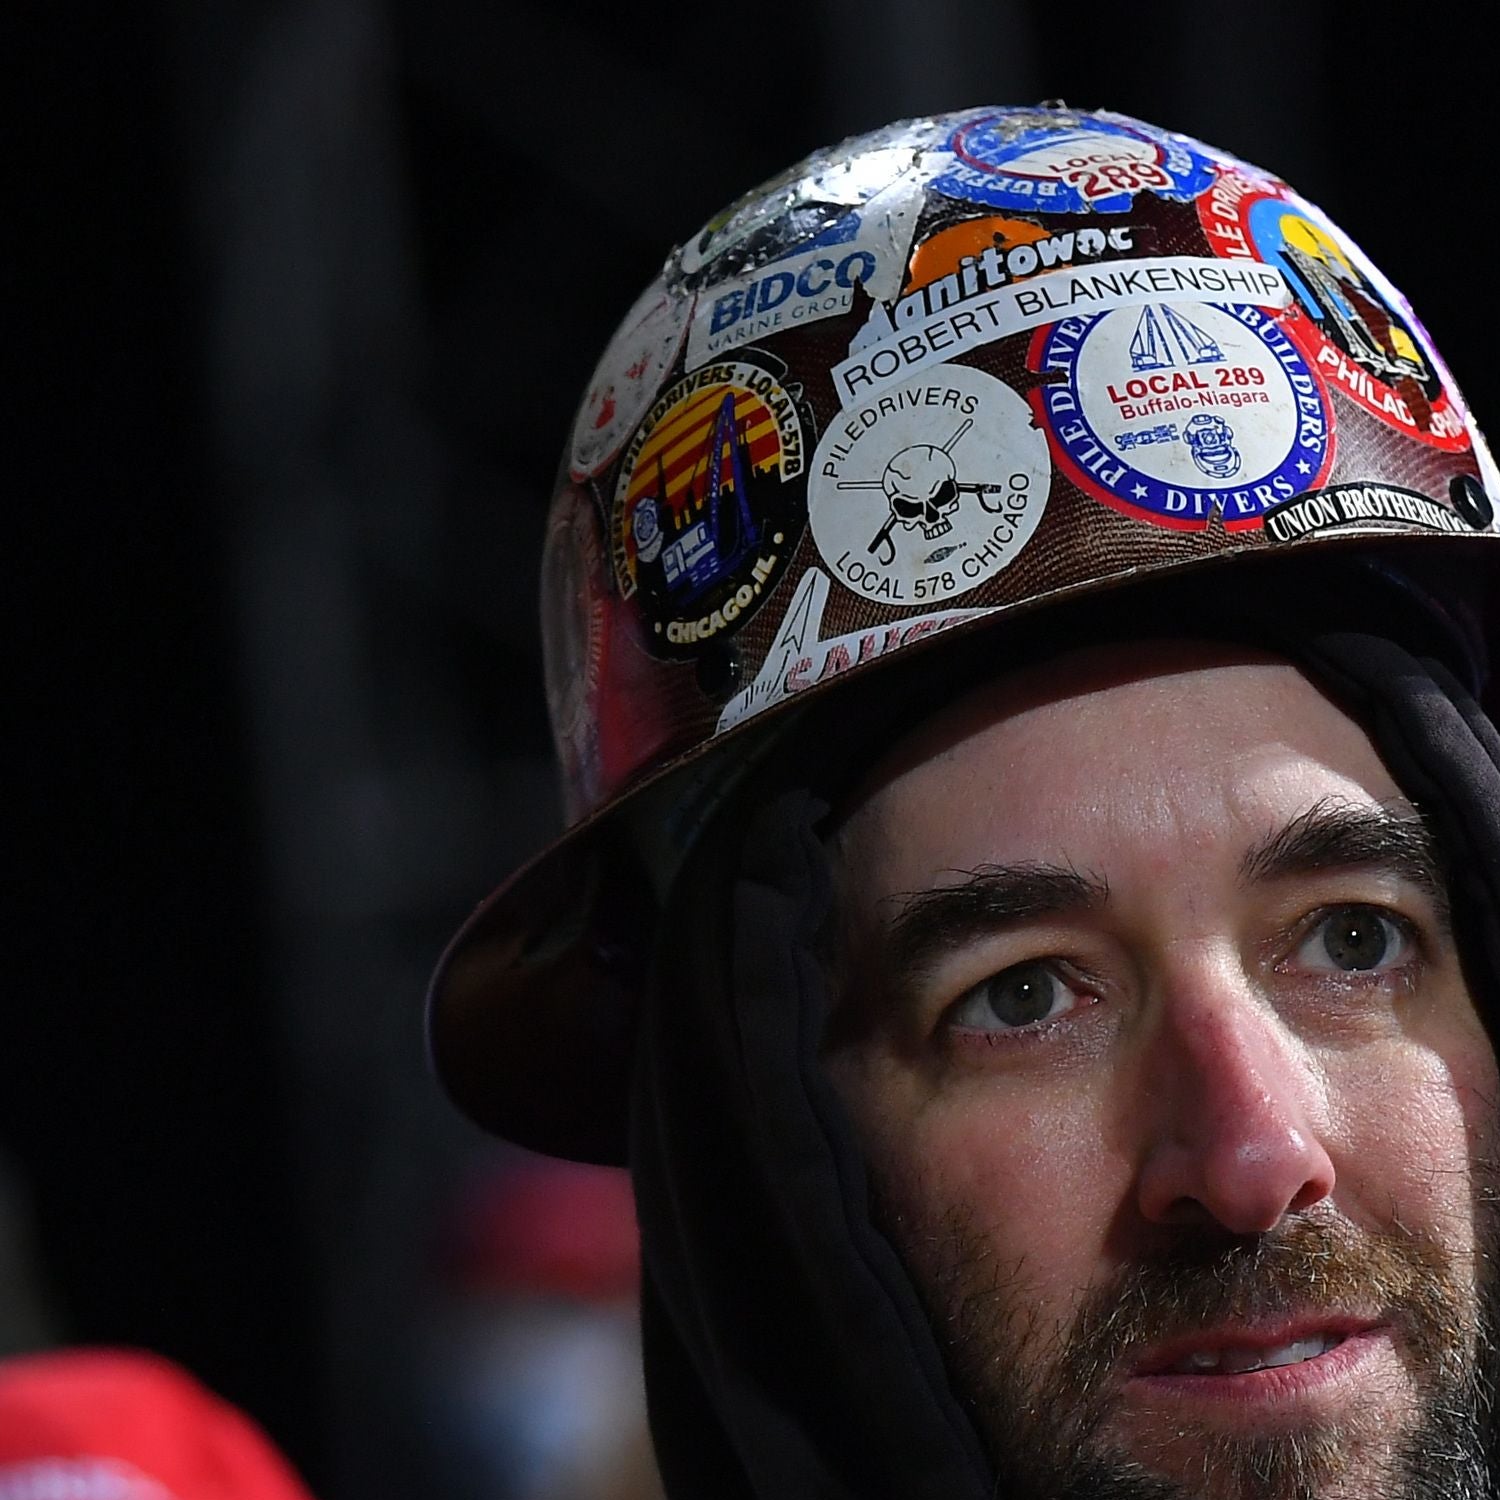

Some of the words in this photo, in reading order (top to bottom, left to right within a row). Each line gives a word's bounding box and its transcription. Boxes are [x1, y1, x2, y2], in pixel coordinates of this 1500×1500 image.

[1048, 151, 1144, 174] LOCAL
[1069, 162, 1171, 198] 289
[709, 250, 877, 336] BIDCO
[868, 226, 1134, 346] anitowoc
[707, 313, 783, 352] MARINE
[791, 294, 855, 319] GROU
[842, 301, 1002, 398] ROBERT
[1013, 266, 1281, 318] BLANKENSHIP
[1106, 371, 1208, 404] LOCAL
[1214, 367, 1265, 387] 289
[1120, 390, 1270, 420] Buffalo-Niagara
[822, 387, 979, 479] PILEDRIVERS
[1059, 419, 1128, 489] PILE
[1165, 474, 1295, 515] DIVERS
[1267, 492, 1342, 542] UNION
[835, 551, 905, 600] LOCAL
[914, 571, 956, 599] 578
[961, 473, 1030, 579] CHICAGO
